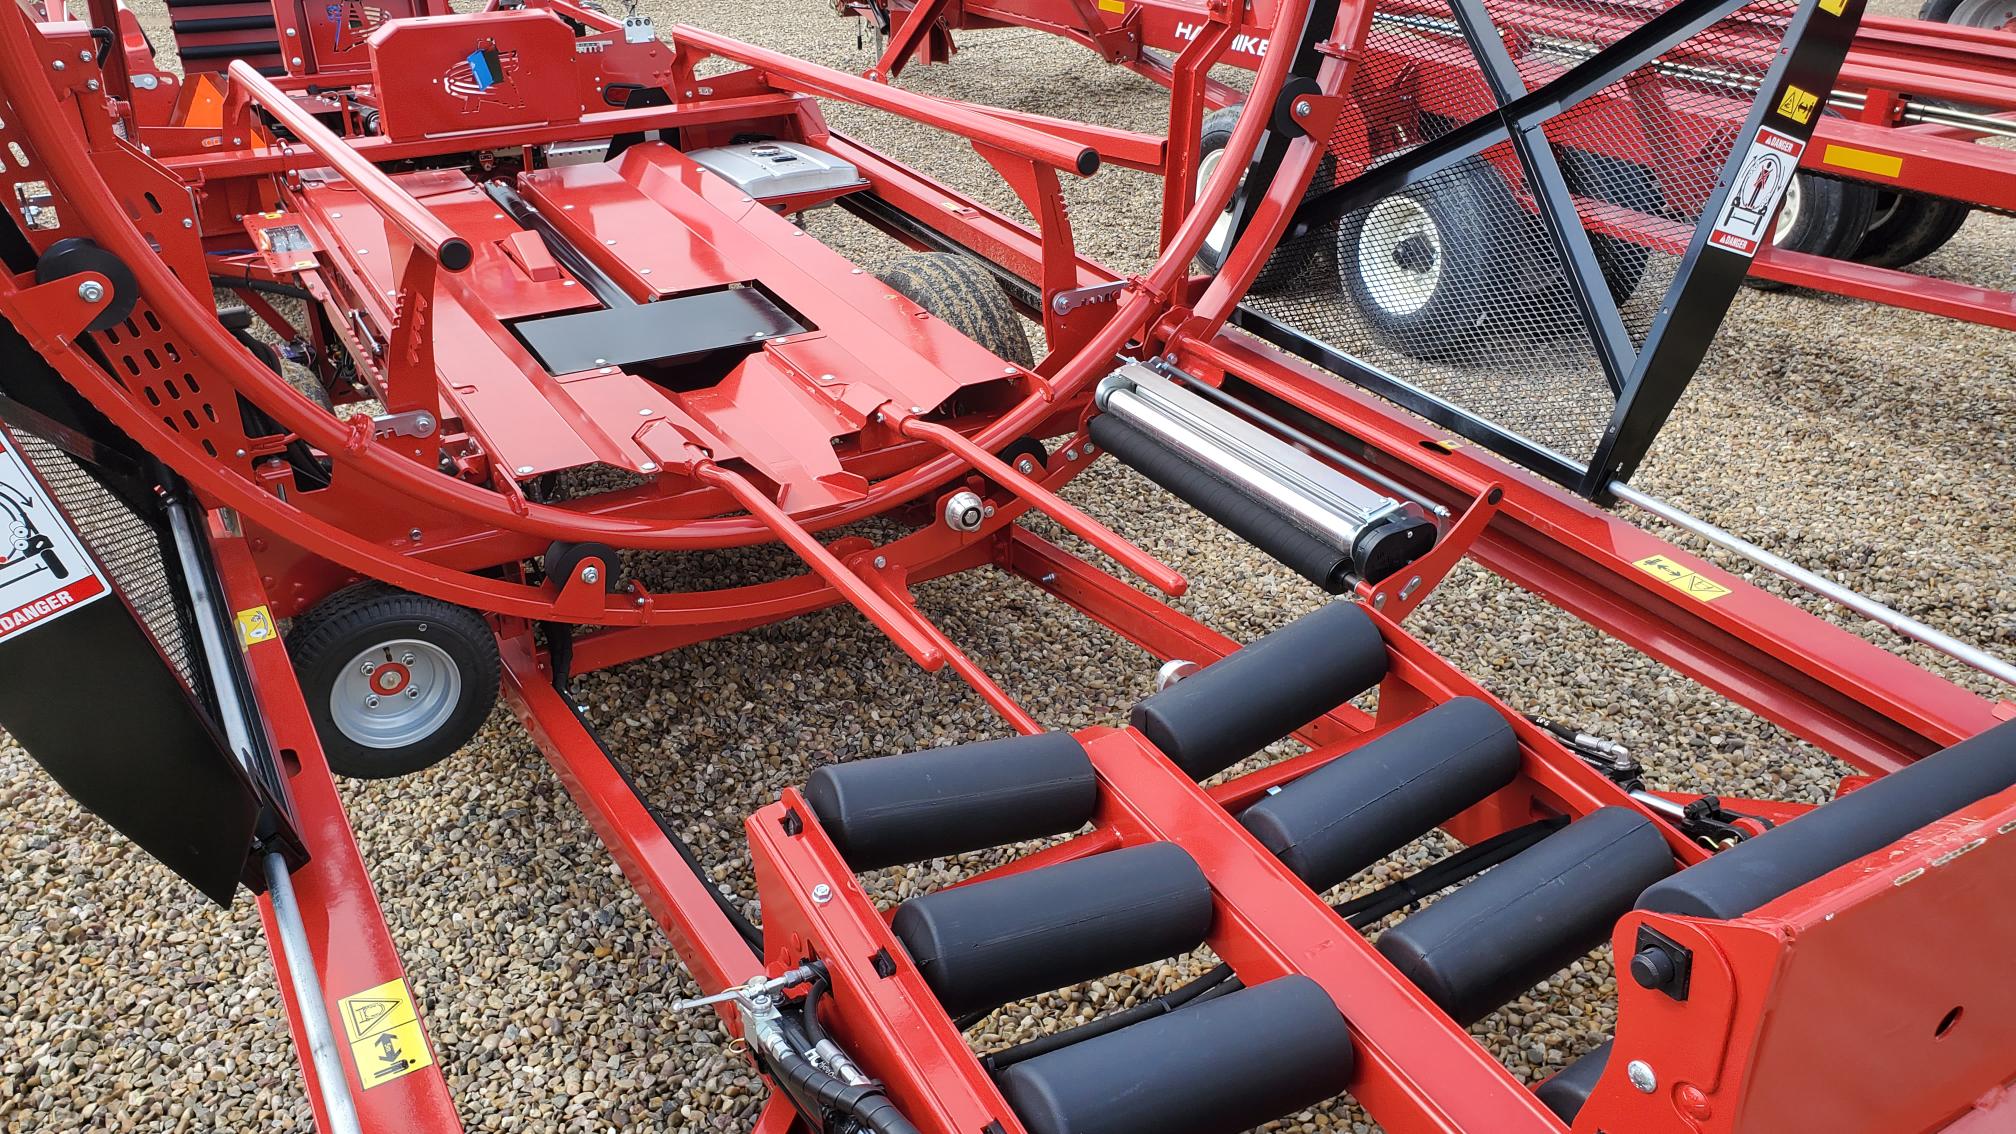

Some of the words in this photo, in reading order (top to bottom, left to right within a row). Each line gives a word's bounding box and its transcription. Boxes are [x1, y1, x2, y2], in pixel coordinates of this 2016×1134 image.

[1769, 136, 1794, 153] DANGER
[1724, 234, 1748, 250] DANGER
[0, 590, 74, 631] DANGER
